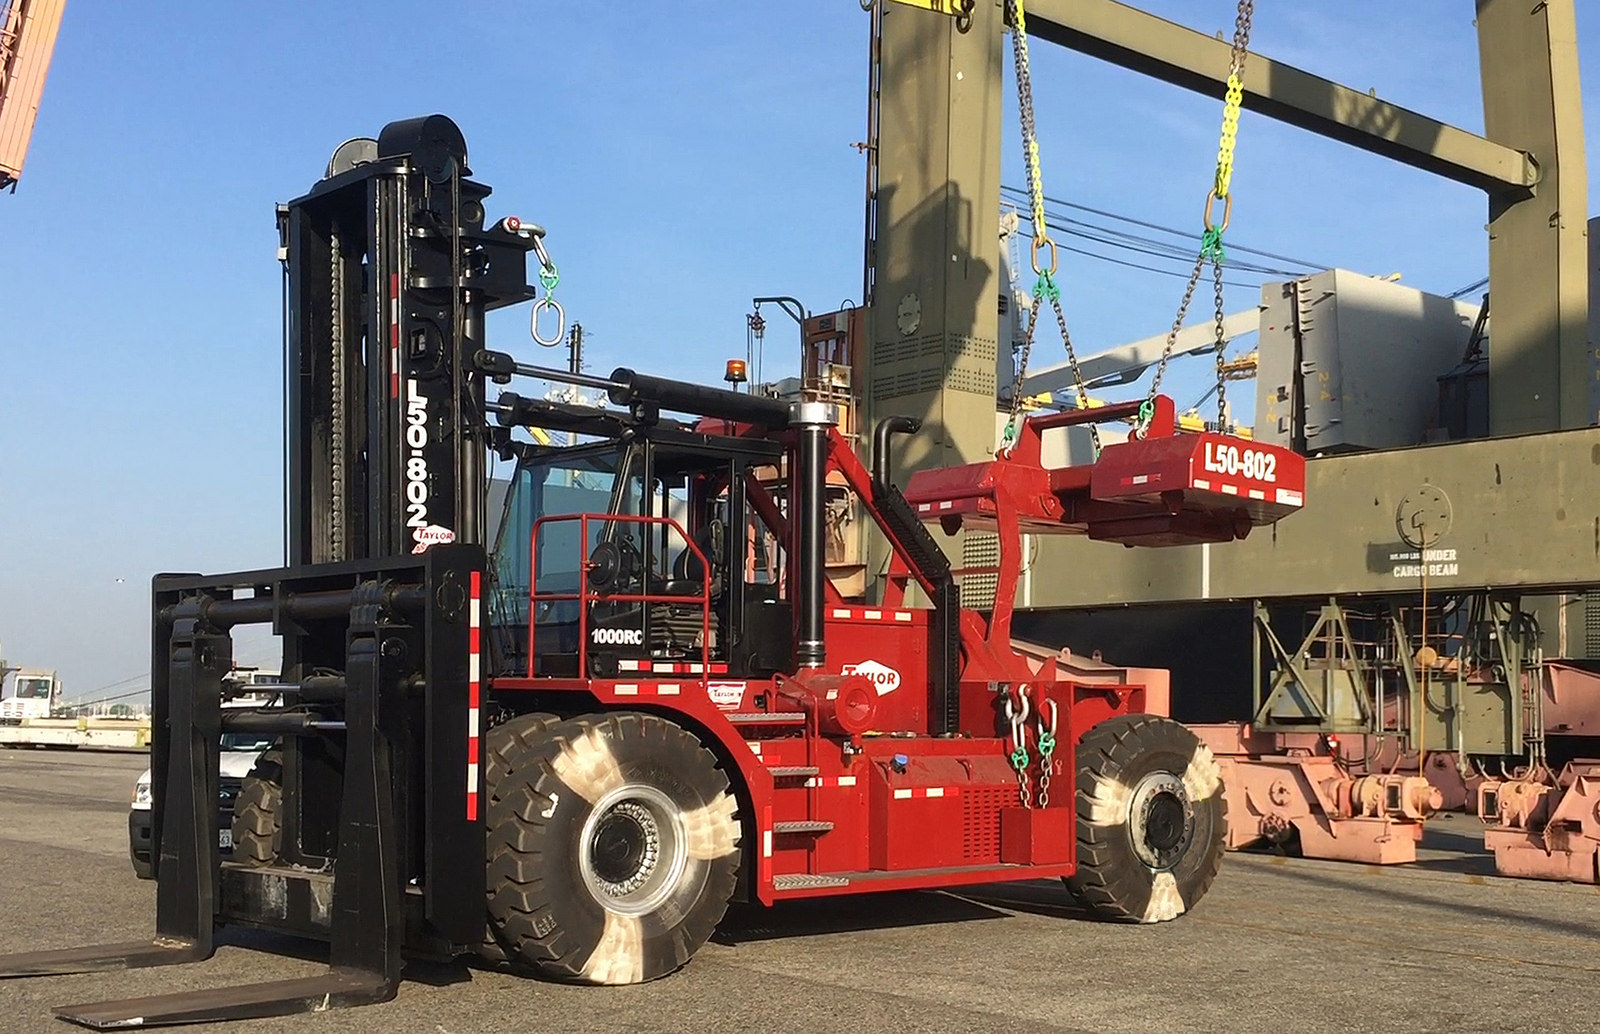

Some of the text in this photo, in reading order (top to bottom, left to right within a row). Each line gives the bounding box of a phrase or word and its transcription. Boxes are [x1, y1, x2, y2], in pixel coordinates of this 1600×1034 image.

[406, 379, 428, 528] L50-802
[1205, 442, 1276, 482] L50-802
[418, 528, 453, 540] TAYLOR
[1422, 549, 1457, 562] UNDER
[1393, 563, 1459, 577] CARGO BEAM
[591, 628, 643, 645] 1000RC
[844, 666, 896, 685] TYLOR
